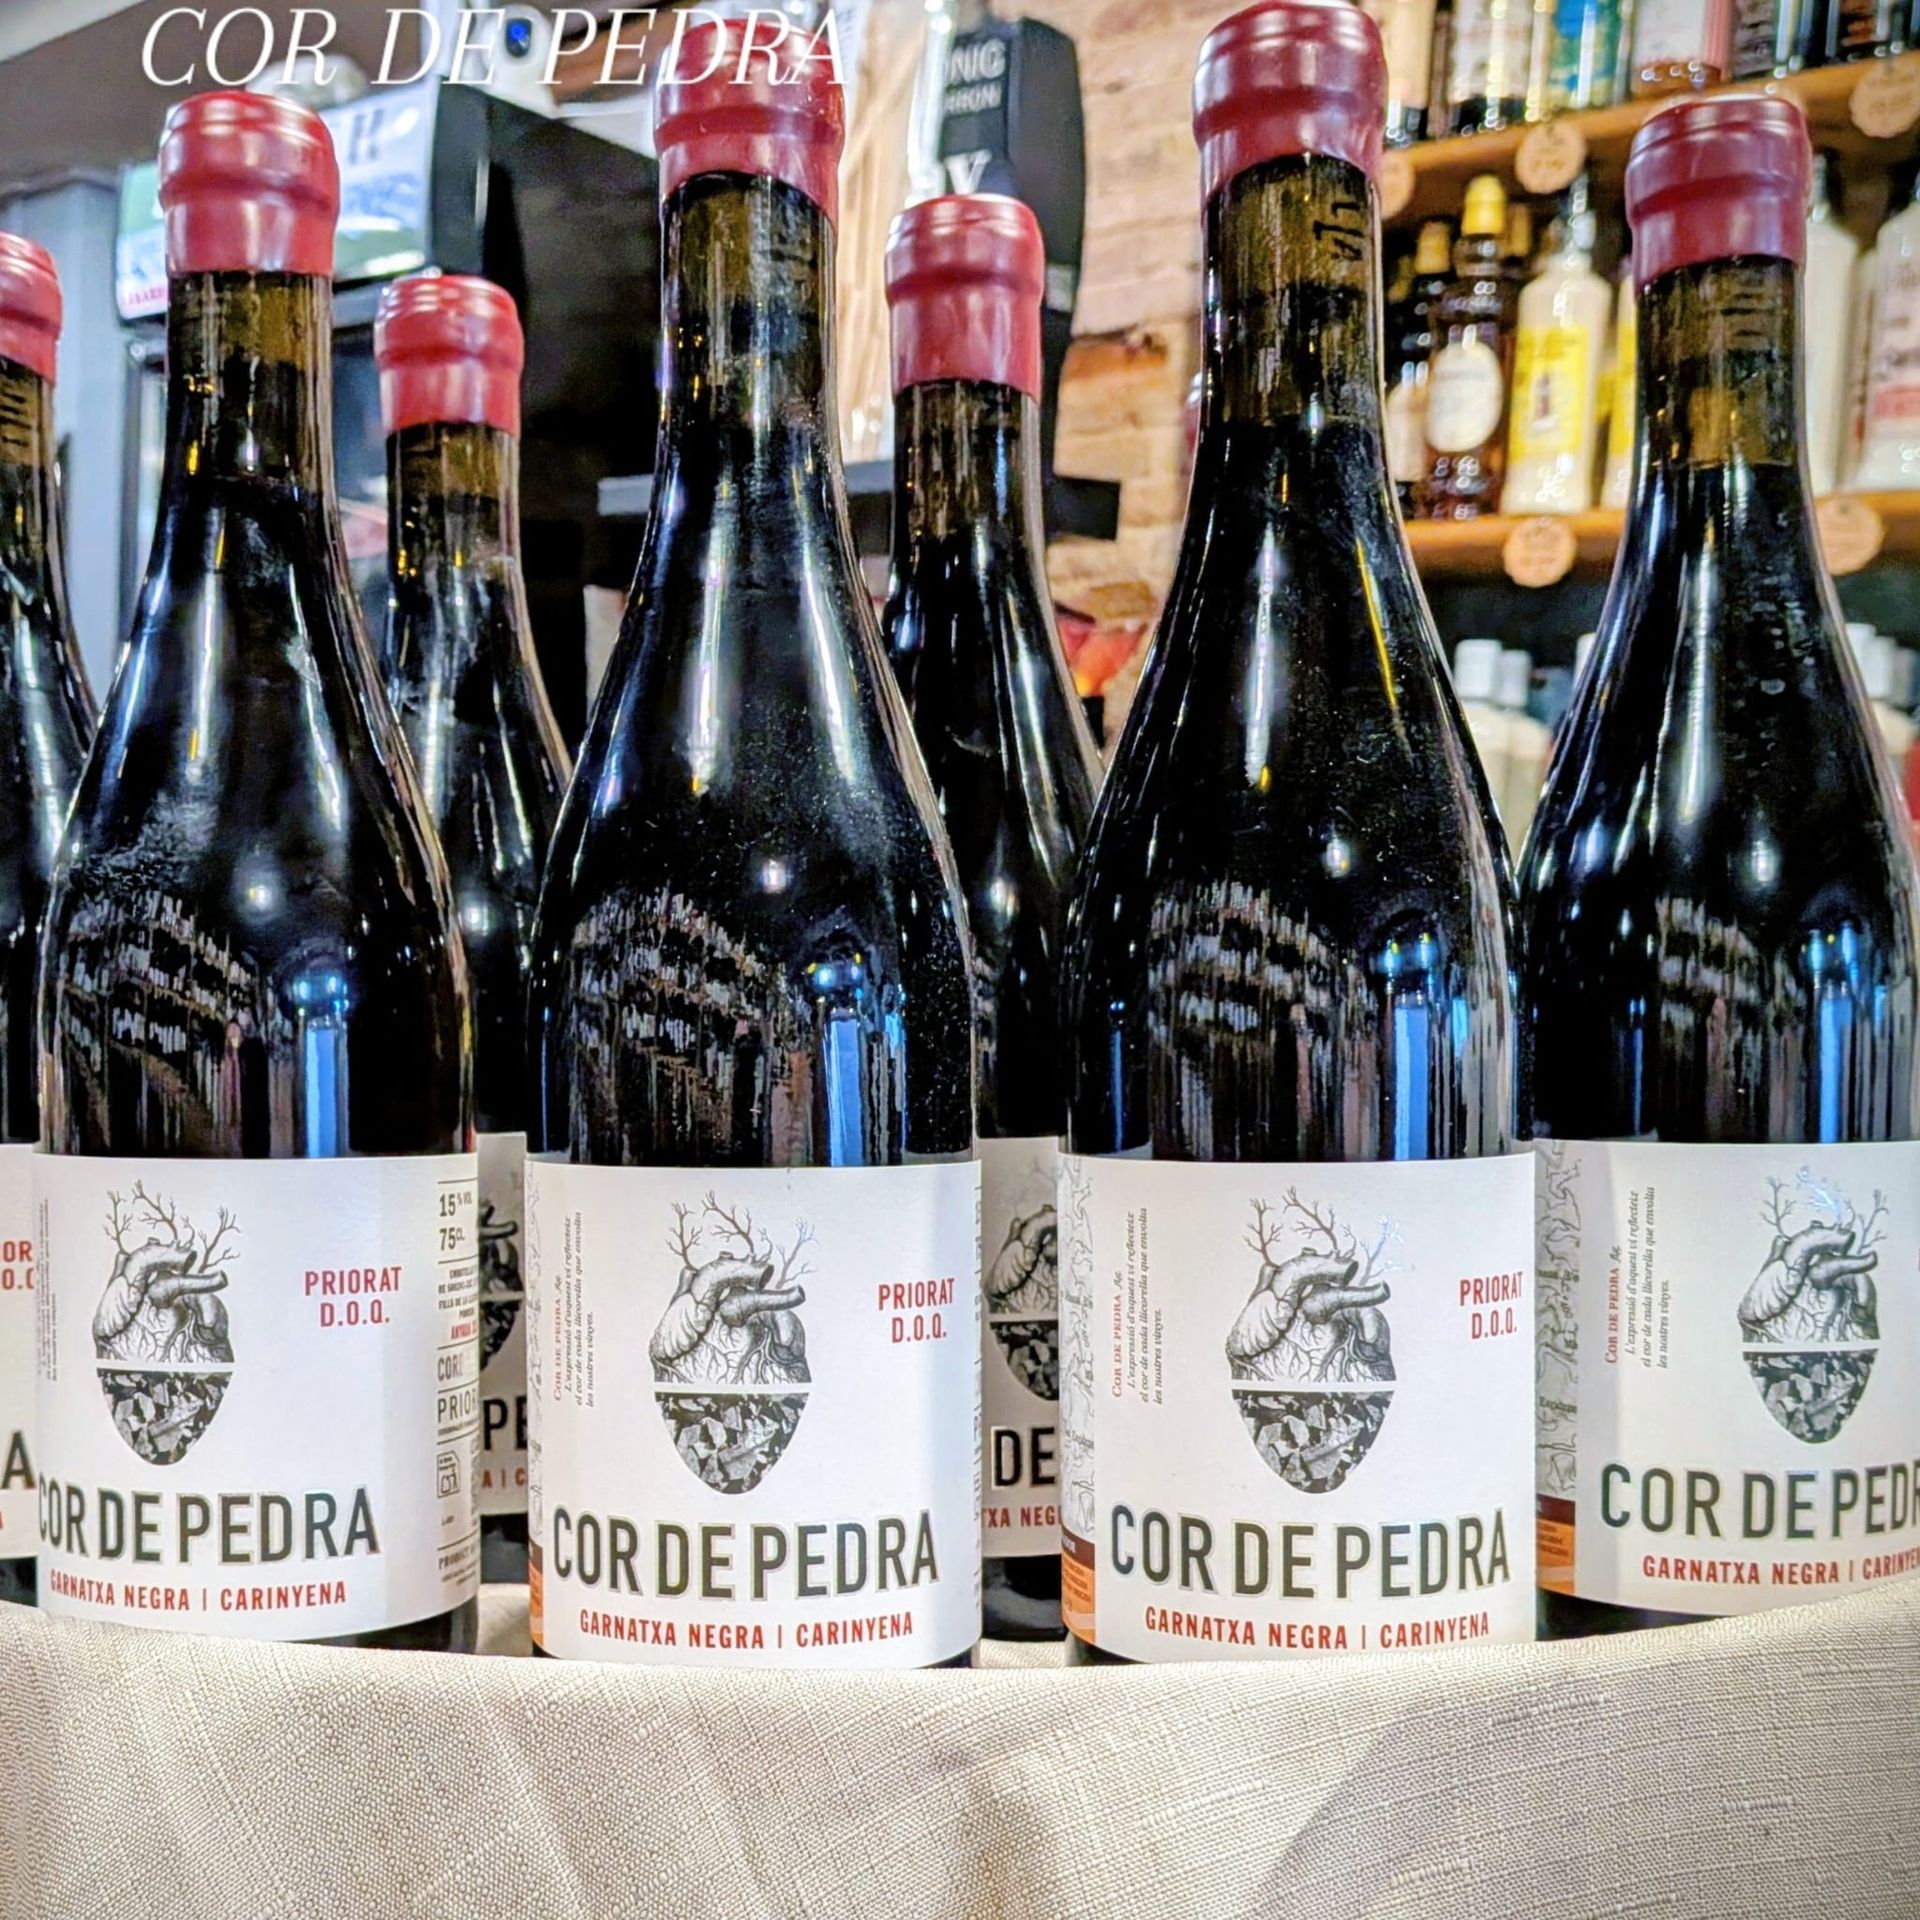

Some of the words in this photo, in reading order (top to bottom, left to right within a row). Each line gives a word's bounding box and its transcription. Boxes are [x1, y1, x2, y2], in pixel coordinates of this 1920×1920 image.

[304, 1265, 402, 1297] PRIORAT
[878, 1277, 955, 1311] PRIORAT
[1459, 1270, 1523, 1307] PRIORAT
[320, 1299, 390, 1328] D.O.Q.
[891, 1312, 947, 1344] D.O.Q.
[992, 1426, 1055, 1489] DE
[39, 1470, 88, 1557] COR
[98, 1486, 164, 1565] DE
[175, 1484, 381, 1566] PEDRA
[1600, 1462, 1723, 1538] COR
[1741, 1469, 1818, 1540] DE
[553, 1504, 644, 1597] COR
[655, 1519, 736, 1601] DE
[750, 1508, 940, 1601] PEDRA
[1111, 1503, 1219, 1595] COR
[1231, 1518, 1318, 1600] DE
[1332, 1507, 1511, 1601] PEDRA
[1642, 1554, 1761, 1586] GARNATXA
[1771, 1561, 1840, 1586] NEGRA
[50, 1568, 116, 1606] GARNATXA
[124, 1584, 190, 1611] NEGRA
[220, 1580, 346, 1611] CARINYENA
[579, 1608, 677, 1647] GARNATXA
[688, 1624, 764, 1649] NEGRA
[795, 1611, 913, 1648] CARINYENA
[1145, 1606, 1256, 1646] GARNATXA
[1268, 1624, 1348, 1650] NEGRA
[1380, 1611, 1489, 1649] CARINYENA
